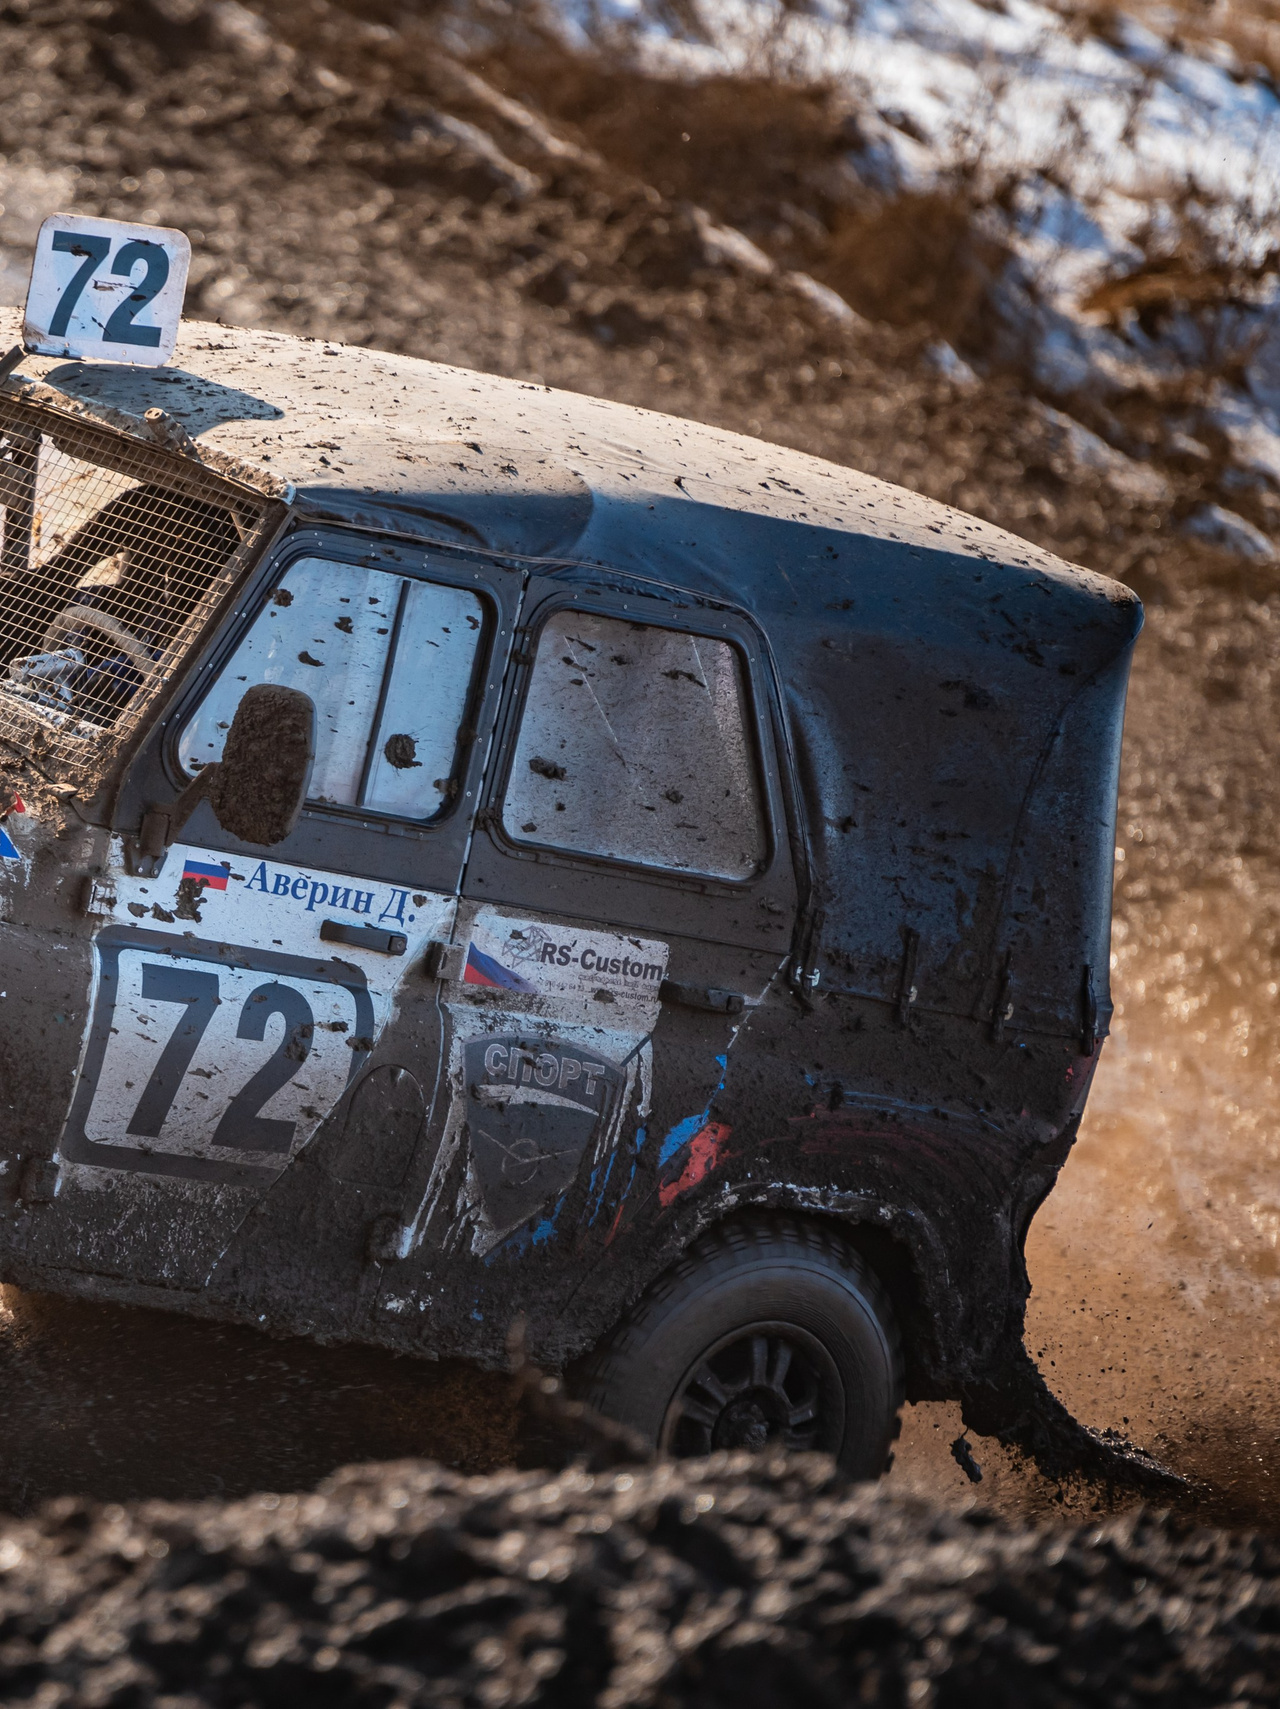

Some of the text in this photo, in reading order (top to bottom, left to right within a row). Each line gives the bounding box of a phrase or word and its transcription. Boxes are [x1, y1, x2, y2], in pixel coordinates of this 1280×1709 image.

[48, 230, 170, 348] 72
[378, 888, 416, 928] Д.
[540, 941, 664, 981] RS-Custom
[125, 962, 314, 1155] 72
[484, 1043, 605, 1096] СПОРТ
